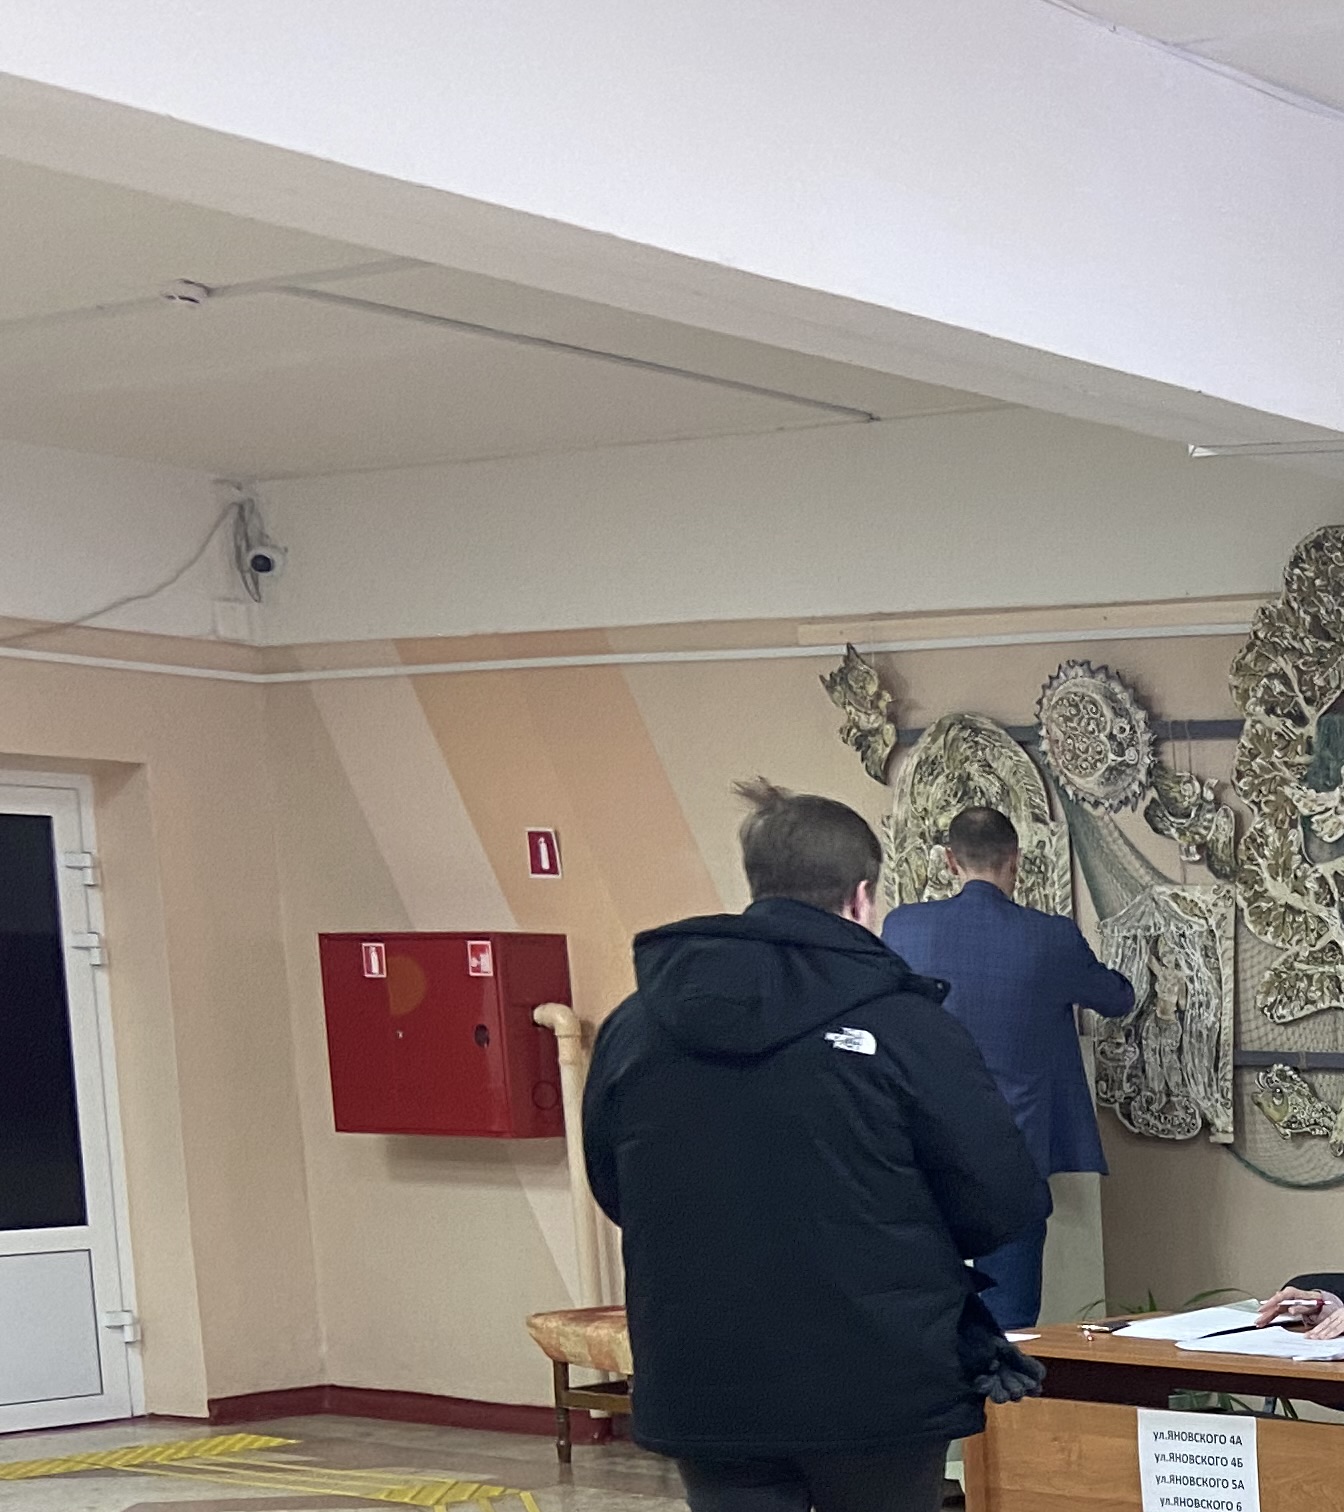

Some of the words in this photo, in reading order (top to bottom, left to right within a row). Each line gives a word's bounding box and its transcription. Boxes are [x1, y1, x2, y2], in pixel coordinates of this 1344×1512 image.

[1153, 1430, 1227, 1445] ул.ЯНОВСКОГО
[1229, 1435, 1243, 1446] 4А
[1154, 1452, 1228, 1467] ул.ЯНОВСКОГО
[1231, 1457, 1244, 1468] 4Б
[1155, 1474, 1229, 1489] ул.ЯНОВСКОГО
[1231, 1479, 1245, 1490] 5А
[1160, 1496, 1233, 1511] ул.ЯНОВСКОГО
[1236, 1502, 1242, 1512] 6
